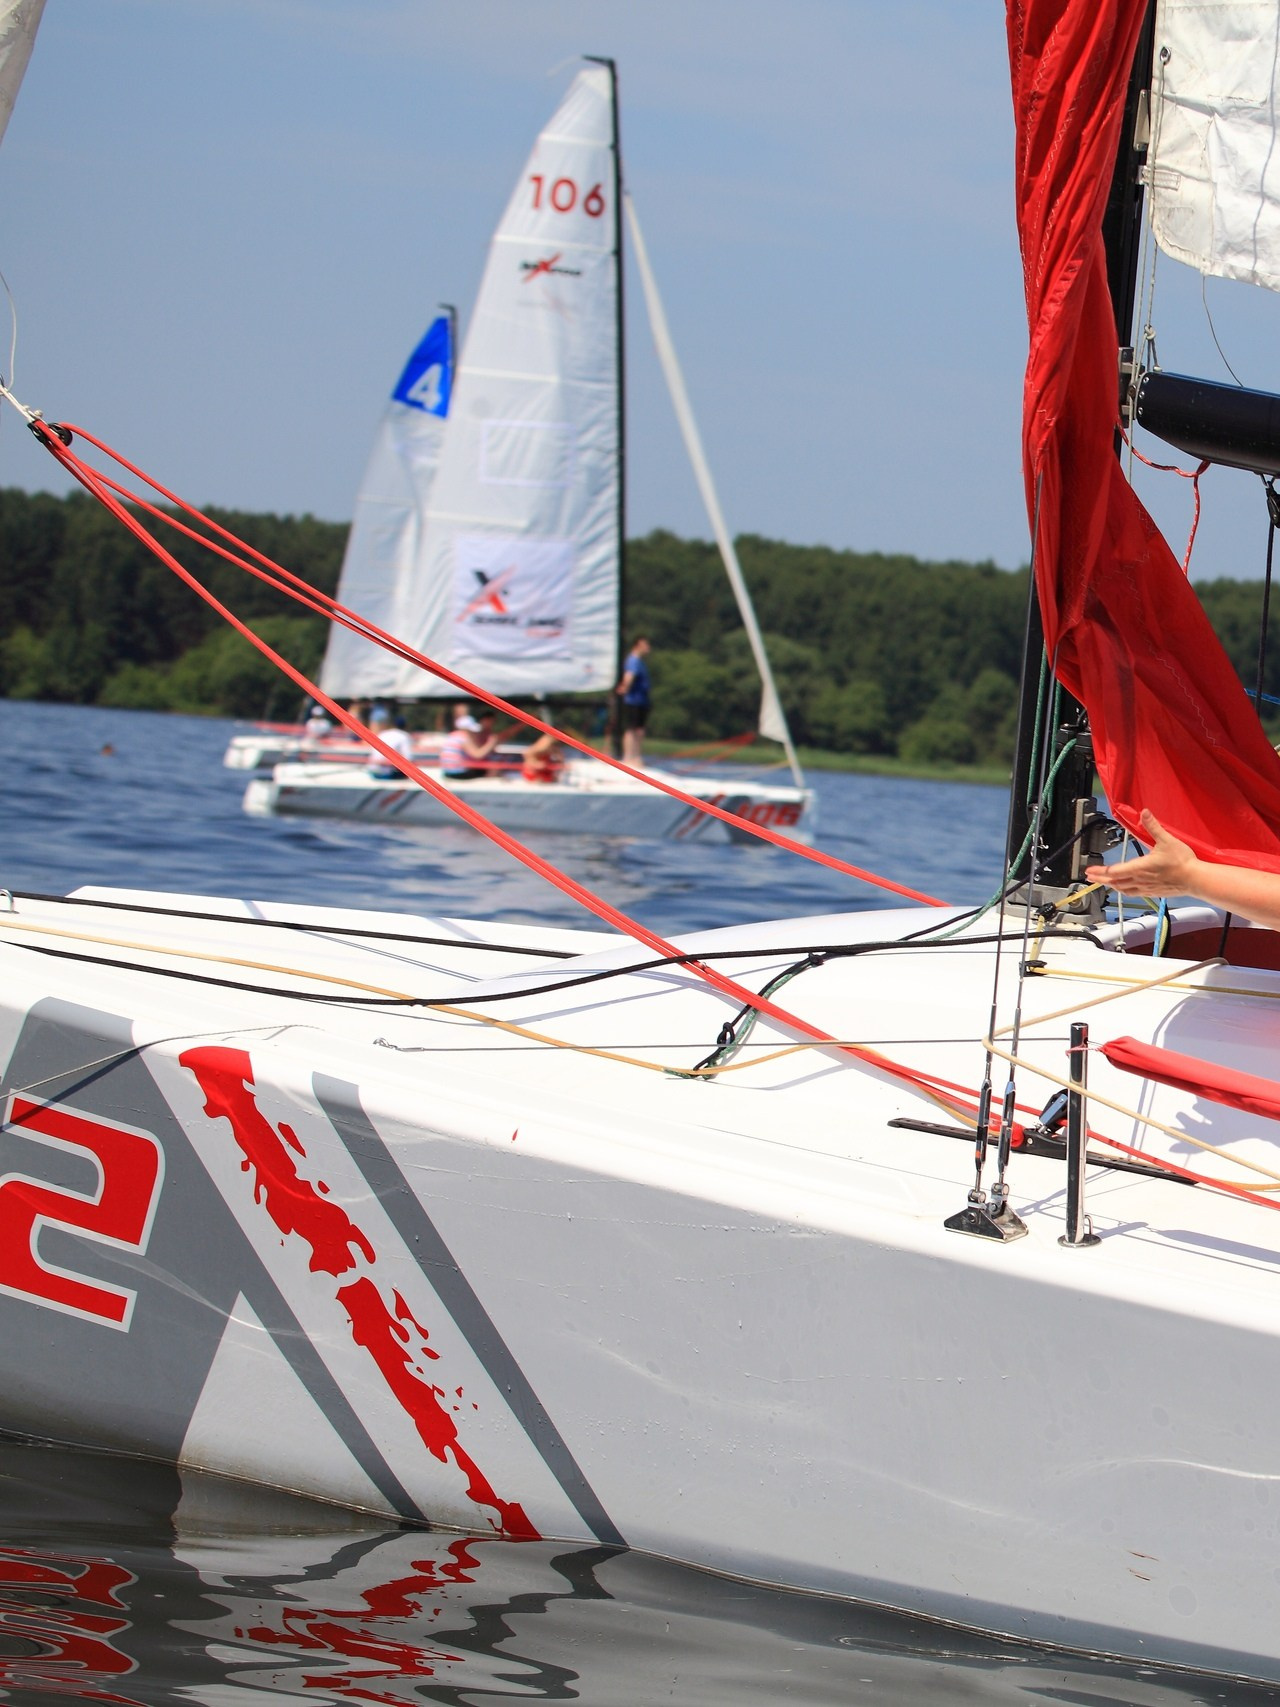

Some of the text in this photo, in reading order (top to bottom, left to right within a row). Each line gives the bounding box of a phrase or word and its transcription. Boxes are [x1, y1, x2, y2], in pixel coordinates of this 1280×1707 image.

[529, 174, 606, 219] 106
[406, 362, 442, 412] 4
[0, 1088, 166, 1333] 2
